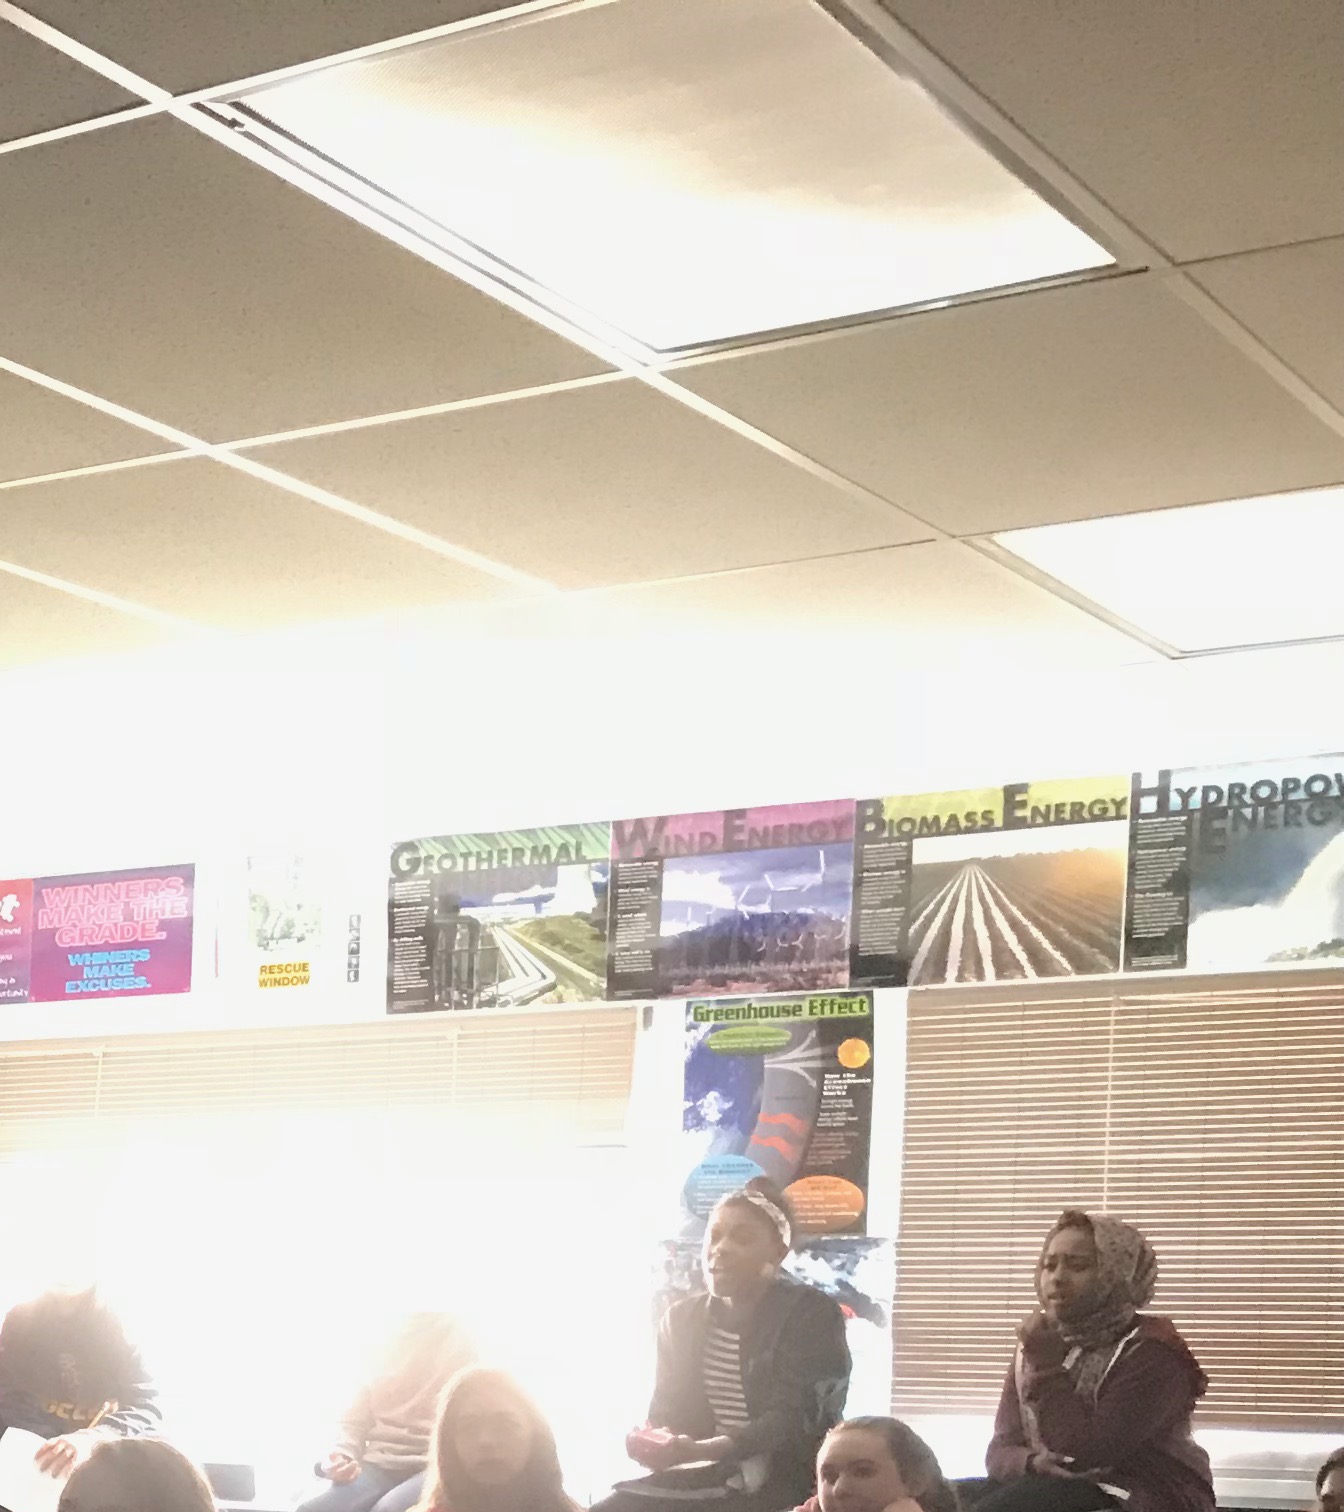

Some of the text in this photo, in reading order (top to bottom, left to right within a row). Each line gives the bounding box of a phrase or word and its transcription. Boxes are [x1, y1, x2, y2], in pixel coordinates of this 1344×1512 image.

[1130, 768, 1344, 815] HYDROPO
[856, 782, 1128, 838] BIOMASS ENERGY
[612, 808, 853, 858] WIND ENERGY
[389, 840, 587, 878] GEOTHERMAL
[41, 876, 185, 909] WINNERS
[38, 896, 189, 930] MAKE THE
[54, 919, 167, 948] GRADE.
[67, 948, 151, 966] WHINERS
[83, 963, 135, 979] MAKE
[259, 962, 310, 976] RESCUE
[65, 976, 152, 994] EXCUSES.
[258, 975, 311, 988] WINDOW
[693, 997, 867, 1022] Greenhouse Effect
